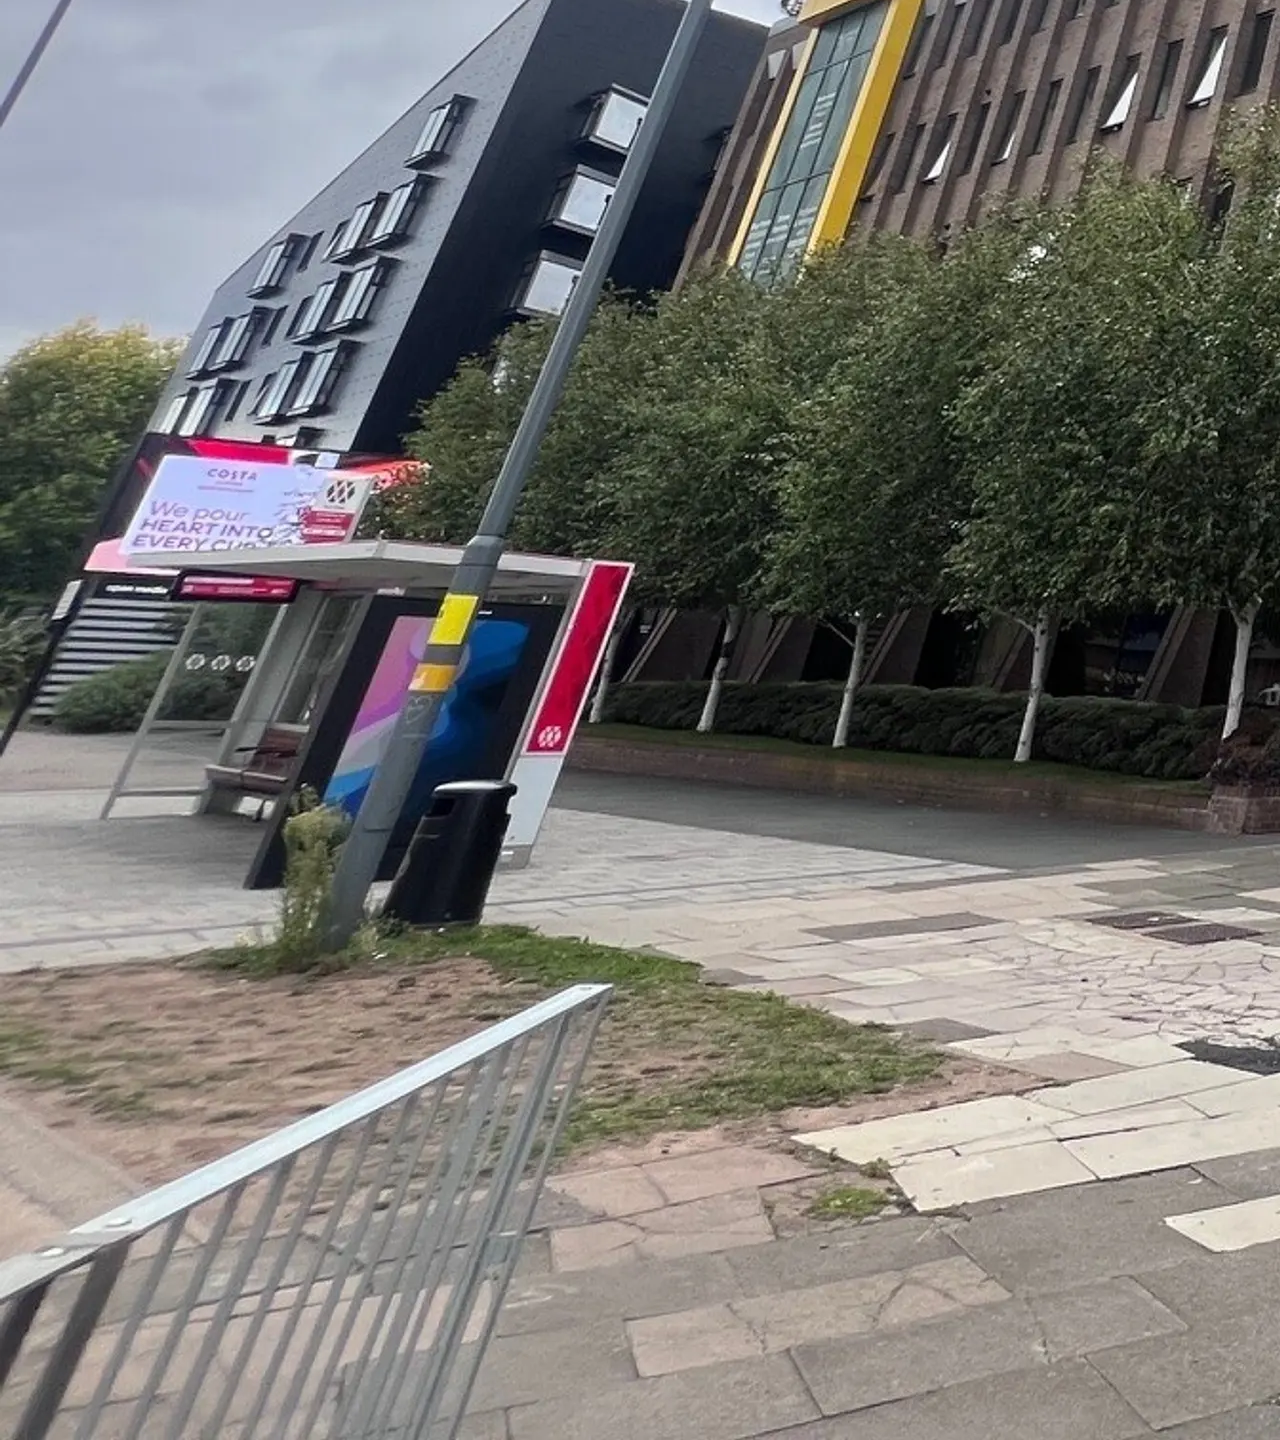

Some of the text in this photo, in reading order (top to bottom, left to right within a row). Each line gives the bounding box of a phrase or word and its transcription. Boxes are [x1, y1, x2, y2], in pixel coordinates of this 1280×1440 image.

[207, 468, 258, 481] COSTA
[150, 501, 249, 524] We pour
[139, 519, 273, 540] HEART INTO
[132, 534, 208, 552] EVERY
